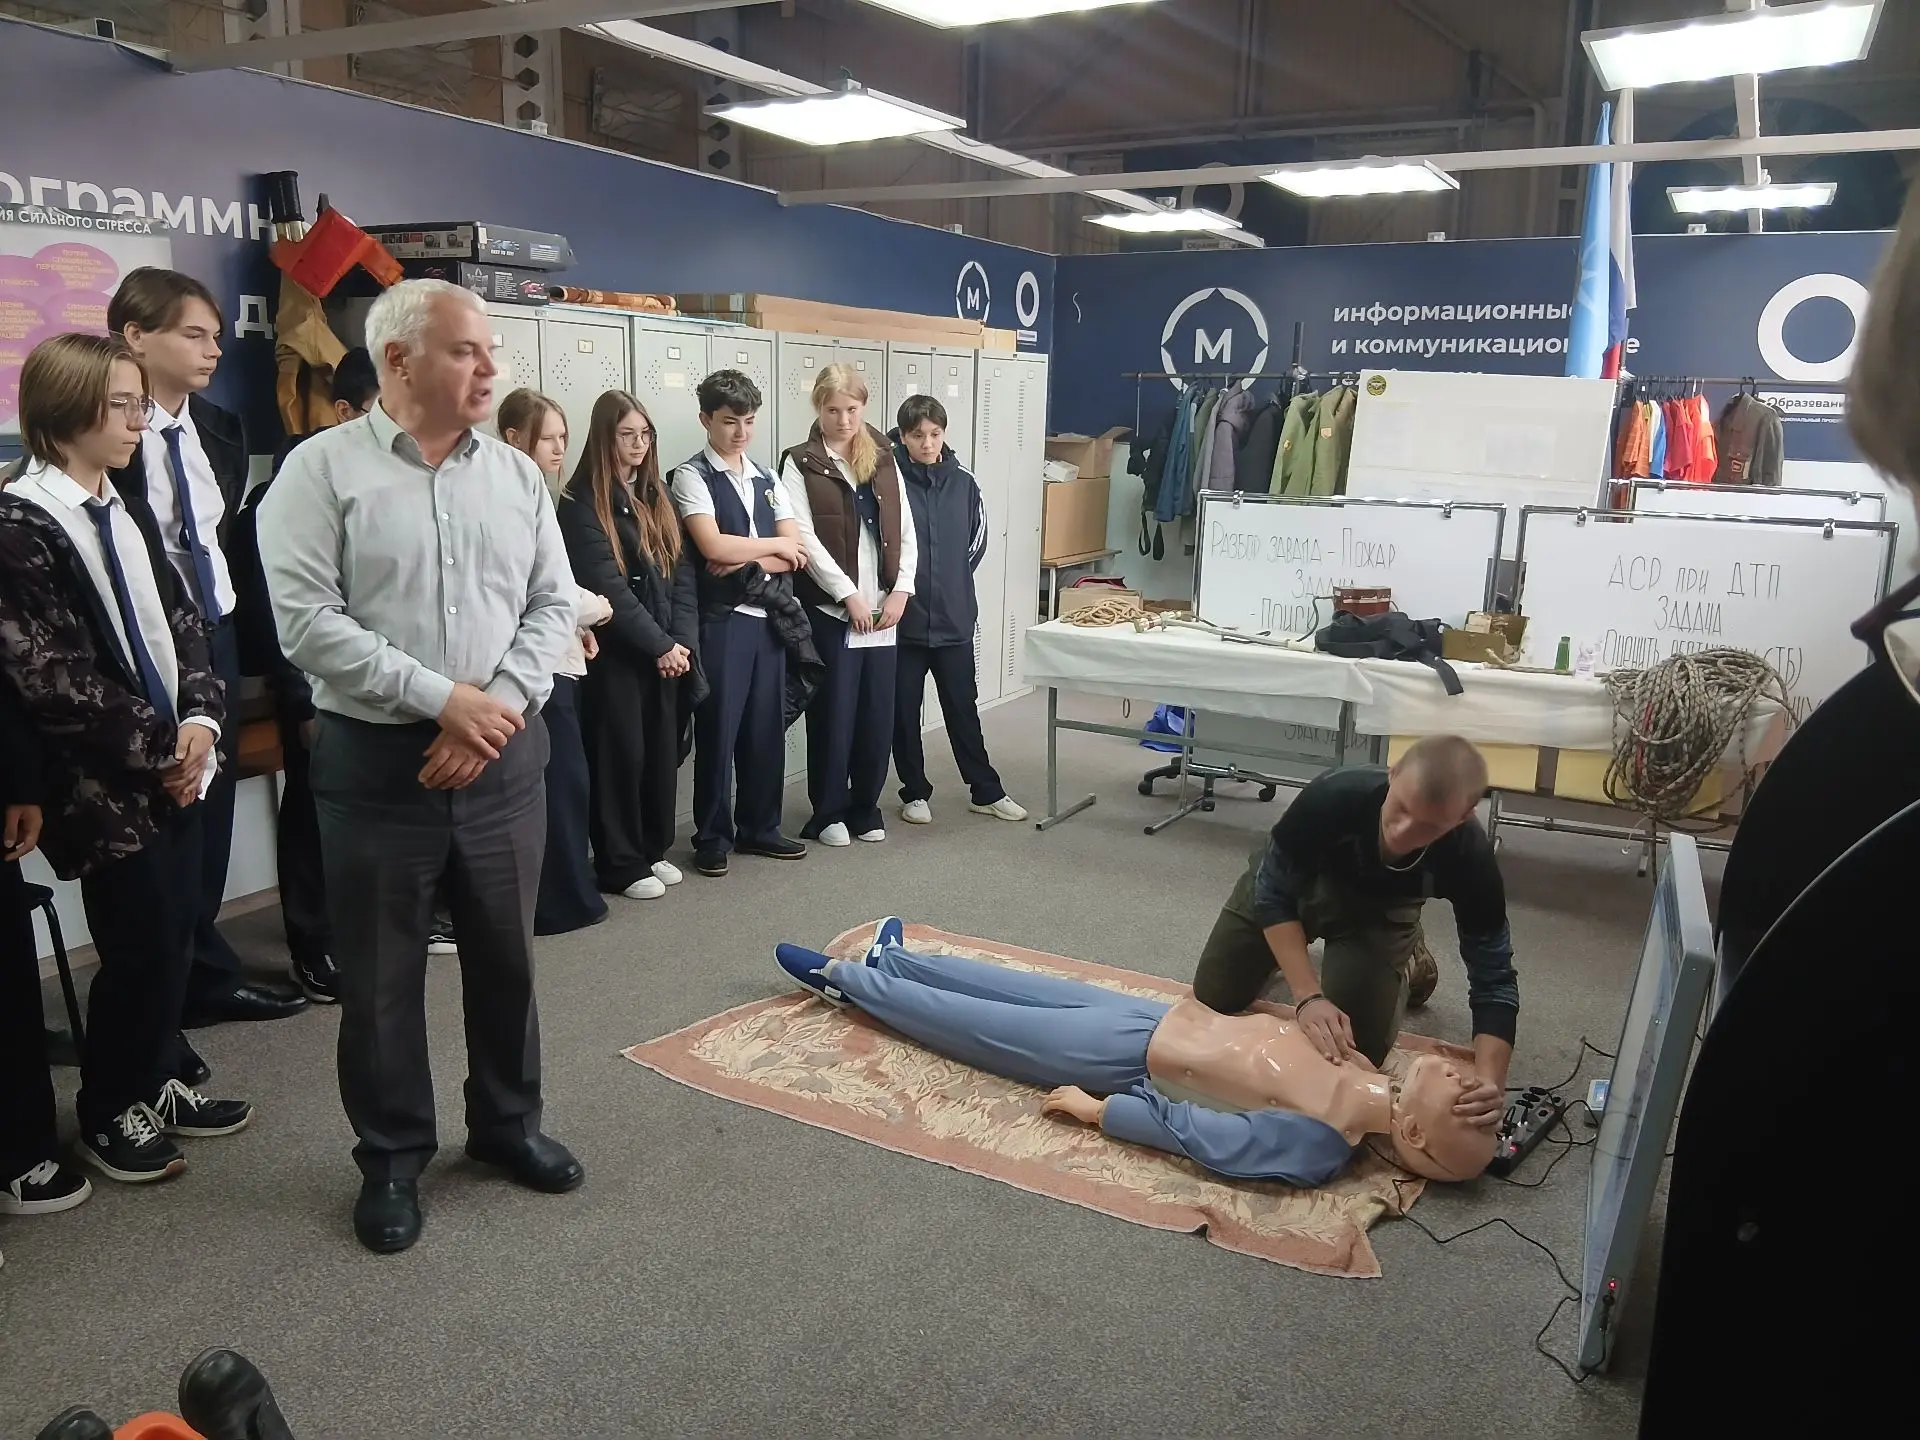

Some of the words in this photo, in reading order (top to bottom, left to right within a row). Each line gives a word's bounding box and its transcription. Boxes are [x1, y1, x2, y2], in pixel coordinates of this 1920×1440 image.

[18, 210, 92, 230] СИЛЬНОГО
[95, 218, 152, 235] СТРЕССА
[1331, 337, 1347, 355] и
[1726, 561, 1781, 599] ДТП
